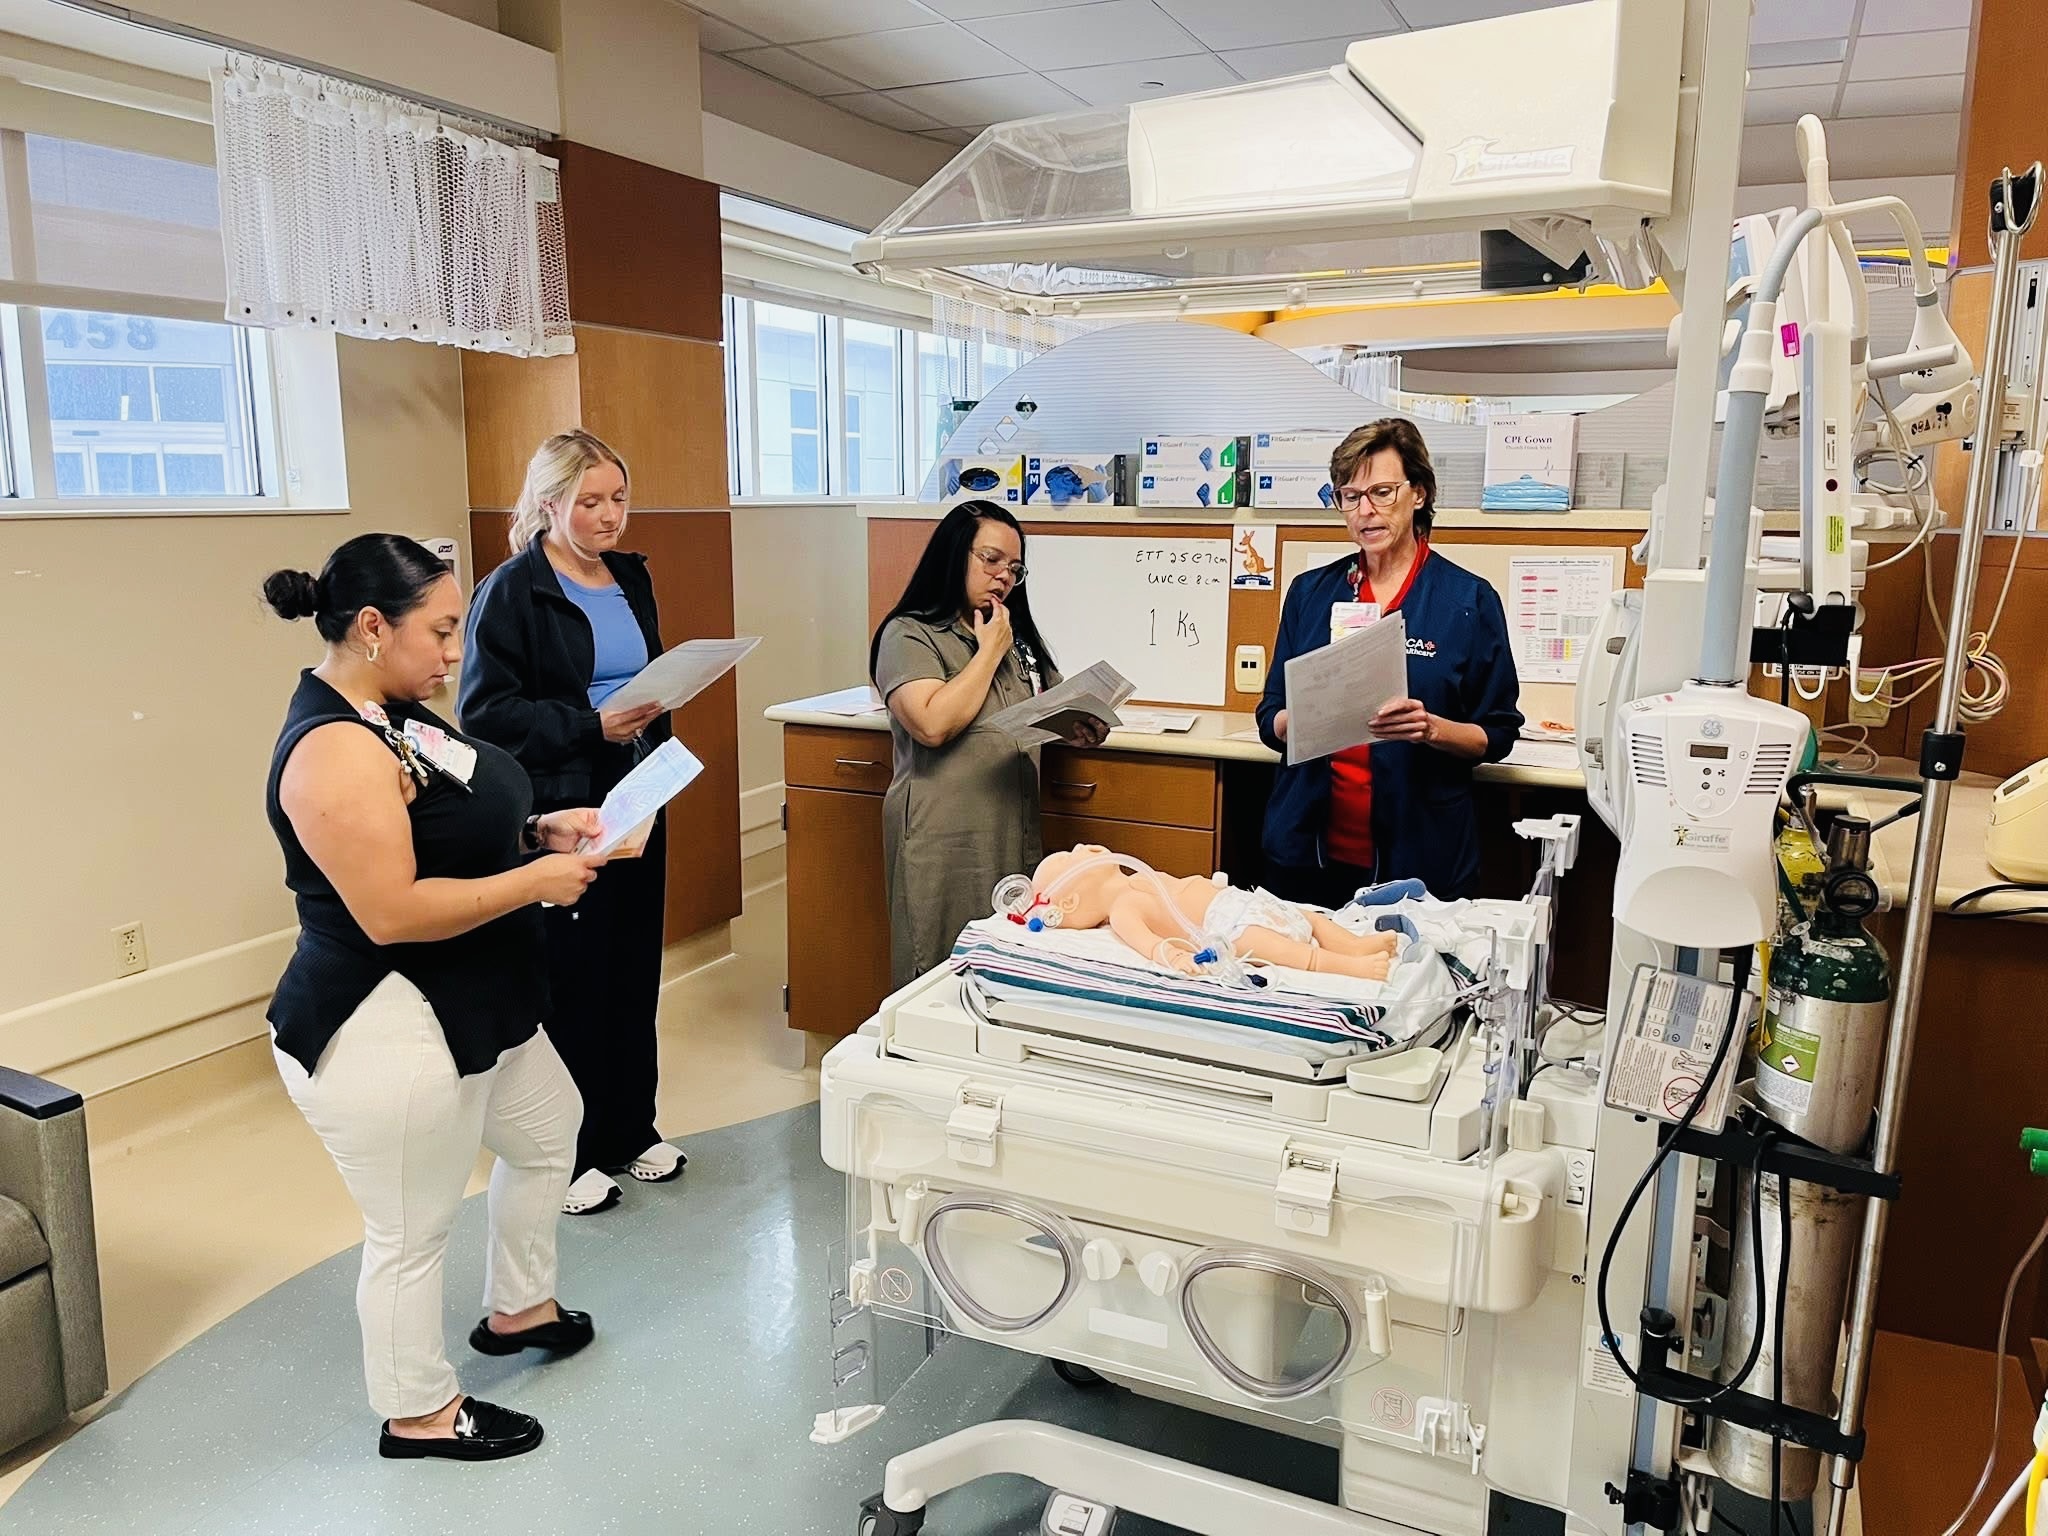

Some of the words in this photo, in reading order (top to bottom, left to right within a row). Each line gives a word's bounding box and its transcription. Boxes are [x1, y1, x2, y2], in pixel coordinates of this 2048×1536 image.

[1524, 435, 1552, 444] Gown
[1223, 455, 1231, 466] L
[1029, 474, 1039, 485] M
[1221, 492, 1228, 503] L
[1135, 550, 1164, 563] ETT
[1149, 608, 1157, 646] 1
[1176, 609, 1200, 648] Kg
[1406, 638, 1424, 650] CA
